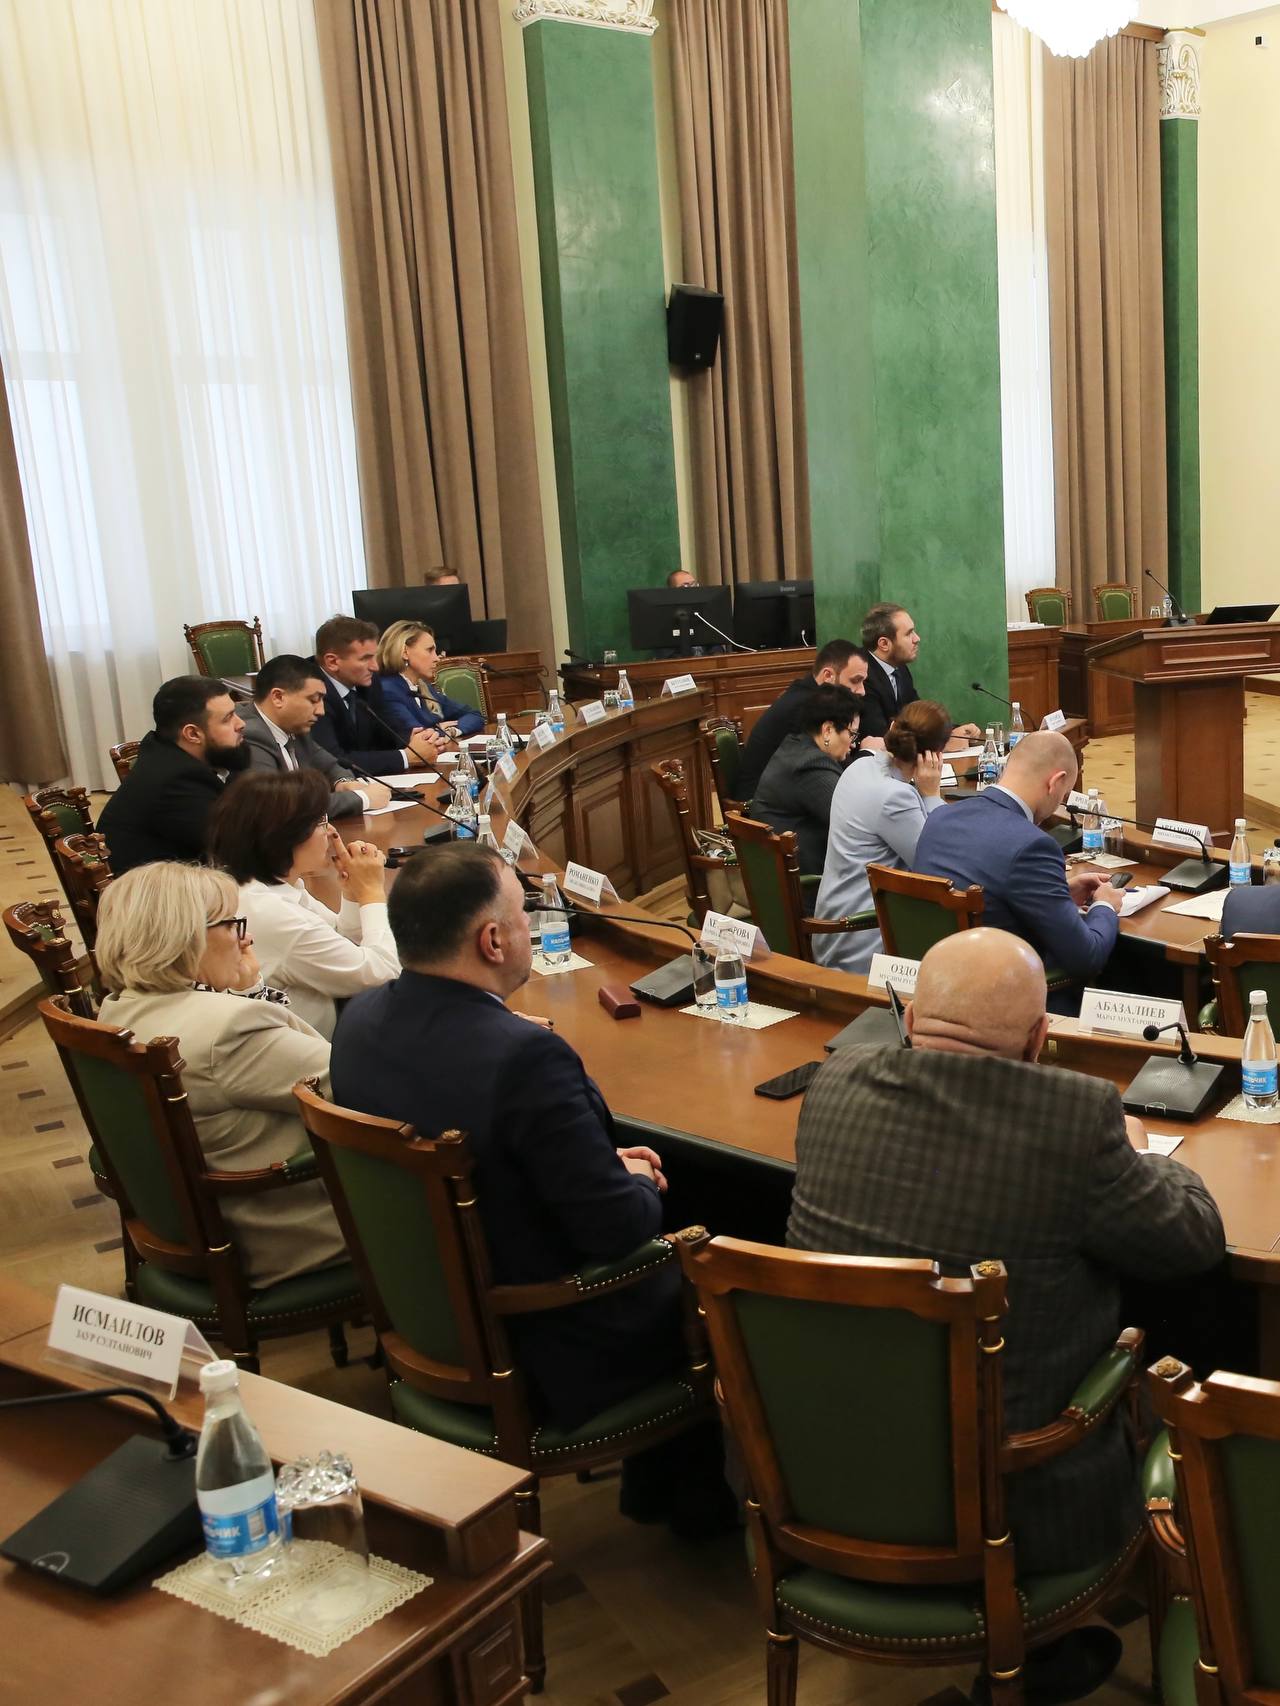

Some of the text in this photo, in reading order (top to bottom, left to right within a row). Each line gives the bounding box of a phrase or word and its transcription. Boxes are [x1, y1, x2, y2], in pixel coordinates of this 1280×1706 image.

[890, 963, 917, 977] ОЗДО
[1094, 1001, 1165, 1019] АБАЗАЛИЕВ
[72, 1304, 165, 1346] ИСМАИЛОВ
